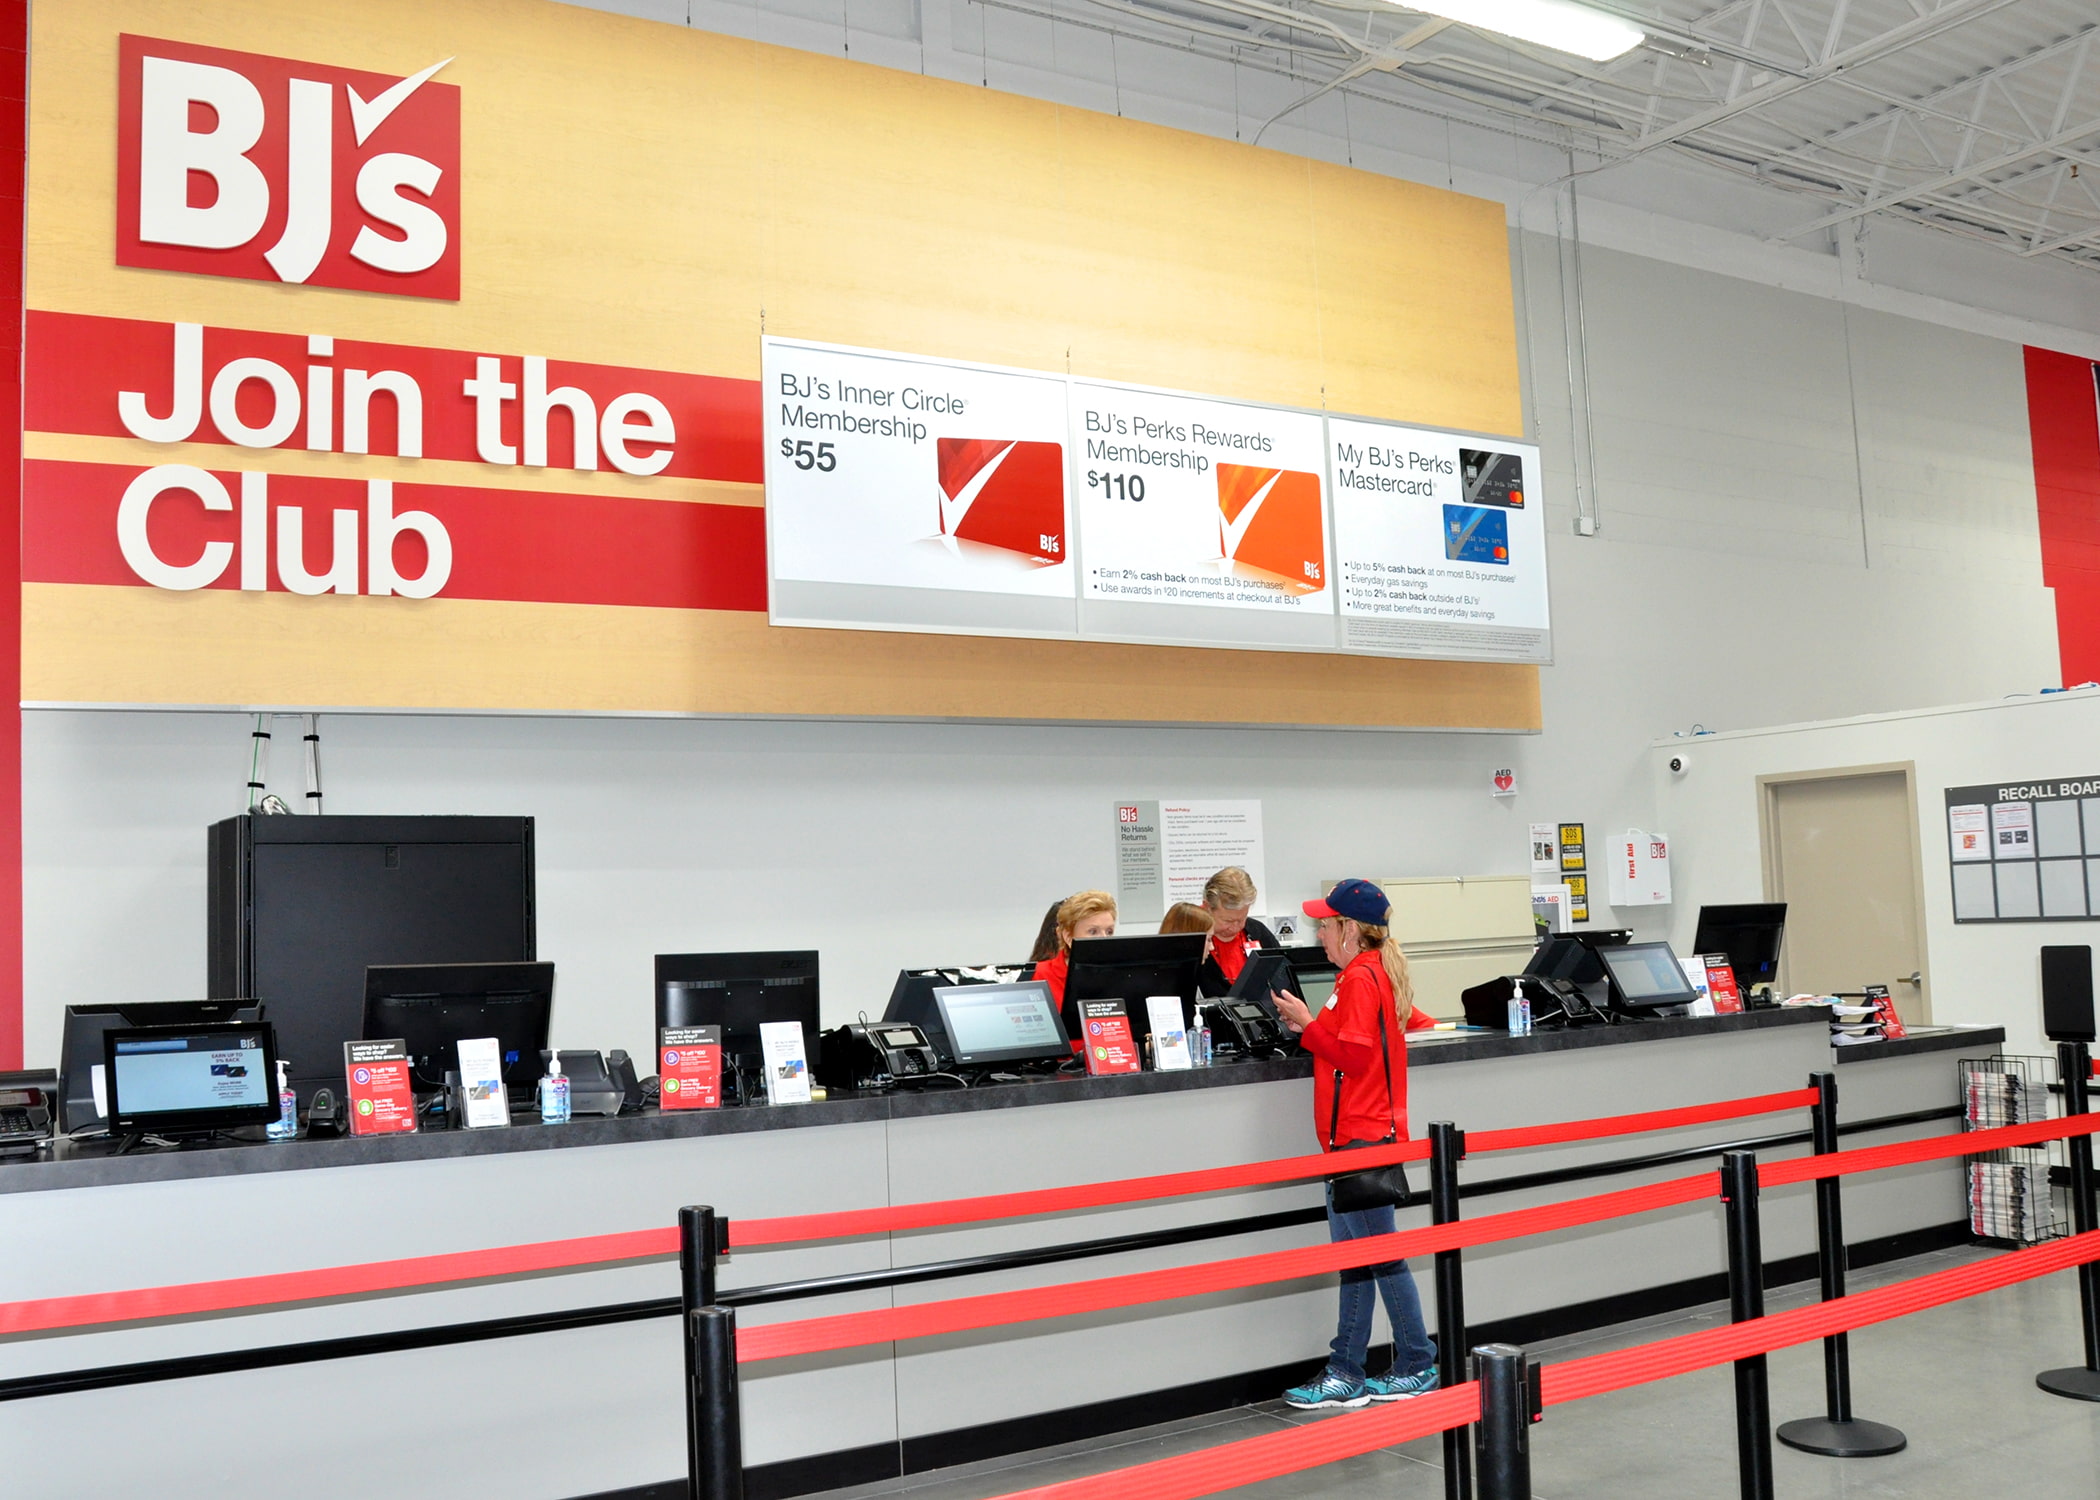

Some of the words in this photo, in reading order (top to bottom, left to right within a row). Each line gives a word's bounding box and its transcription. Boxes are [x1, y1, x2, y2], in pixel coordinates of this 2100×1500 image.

[118, 322, 423, 458] Join
[464, 356, 676, 476] the
[780, 373, 831, 401] BJ's
[839, 380, 895, 407] Inner
[781, 403, 927, 444] Membership
[1086, 410, 1128, 435] BJ's
[1134, 416, 1186, 442] Perks
[780, 437, 837, 472] $55
[1087, 438, 1209, 475] Membership
[1338, 443, 1363, 467] My
[1369, 447, 1404, 469] BJ's
[1087, 469, 1145, 502] $110
[117, 464, 452, 599] Club
[1100, 568, 1121, 579] Earn
[1122, 569, 1138, 580] 2%
[1140, 572, 1162, 581] cash
[1164, 573, 1187, 583] back
[1188, 575, 1200, 583] on
[1201, 576, 1222, 586] most
[1224, 577, 1241, 587] BJ's
[1350, 561, 1362, 572] Up
[1363, 562, 1371, 570] to
[1372, 563, 1386, 572] 5%
[1387, 565, 1406, 574] cash
[1407, 565, 1426, 575] back
[1447, 570, 1464, 579] most
[1465, 571, 1480, 580] BJ's
[1351, 574, 1385, 586] Everyday
[1386, 577, 1399, 586] gas
[1401, 578, 1428, 589] savings
[1100, 583, 1118, 593] Use
[1121, 585, 1152, 595] awards
[1154, 587, 1162, 595] in
[1163, 587, 1178, 597] $20
[1180, 588, 1225, 600] increments
[1226, 592, 1235, 600] at
[1237, 592, 1273, 603] checkout
[1275, 595, 1283, 604] at
[1284, 595, 1301, 605] BJ's
[1352, 588, 1363, 598] Up
[1364, 589, 1372, 597] to
[1373, 589, 1387, 598] 2%
[1389, 591, 1407, 600] cash
[1409, 592, 1427, 601] back
[1429, 594, 1454, 603] outside
[1456, 595, 1463, 604] of
[1352, 601, 1372, 610] More
[1373, 602, 1393, 613] great
[1394, 603, 1422, 614] benefits
[1423, 606, 1437, 615] and
[1438, 608, 1470, 619] everyday
[1470, 611, 1495, 620] savings
[1495, 769, 1512, 777] AED
[1999, 785, 2056, 800] RECALL
[1120, 807, 1137, 822] BJ's
[1121, 833, 1147, 842] Returns
[1132, 824, 1154, 833] Hassle
